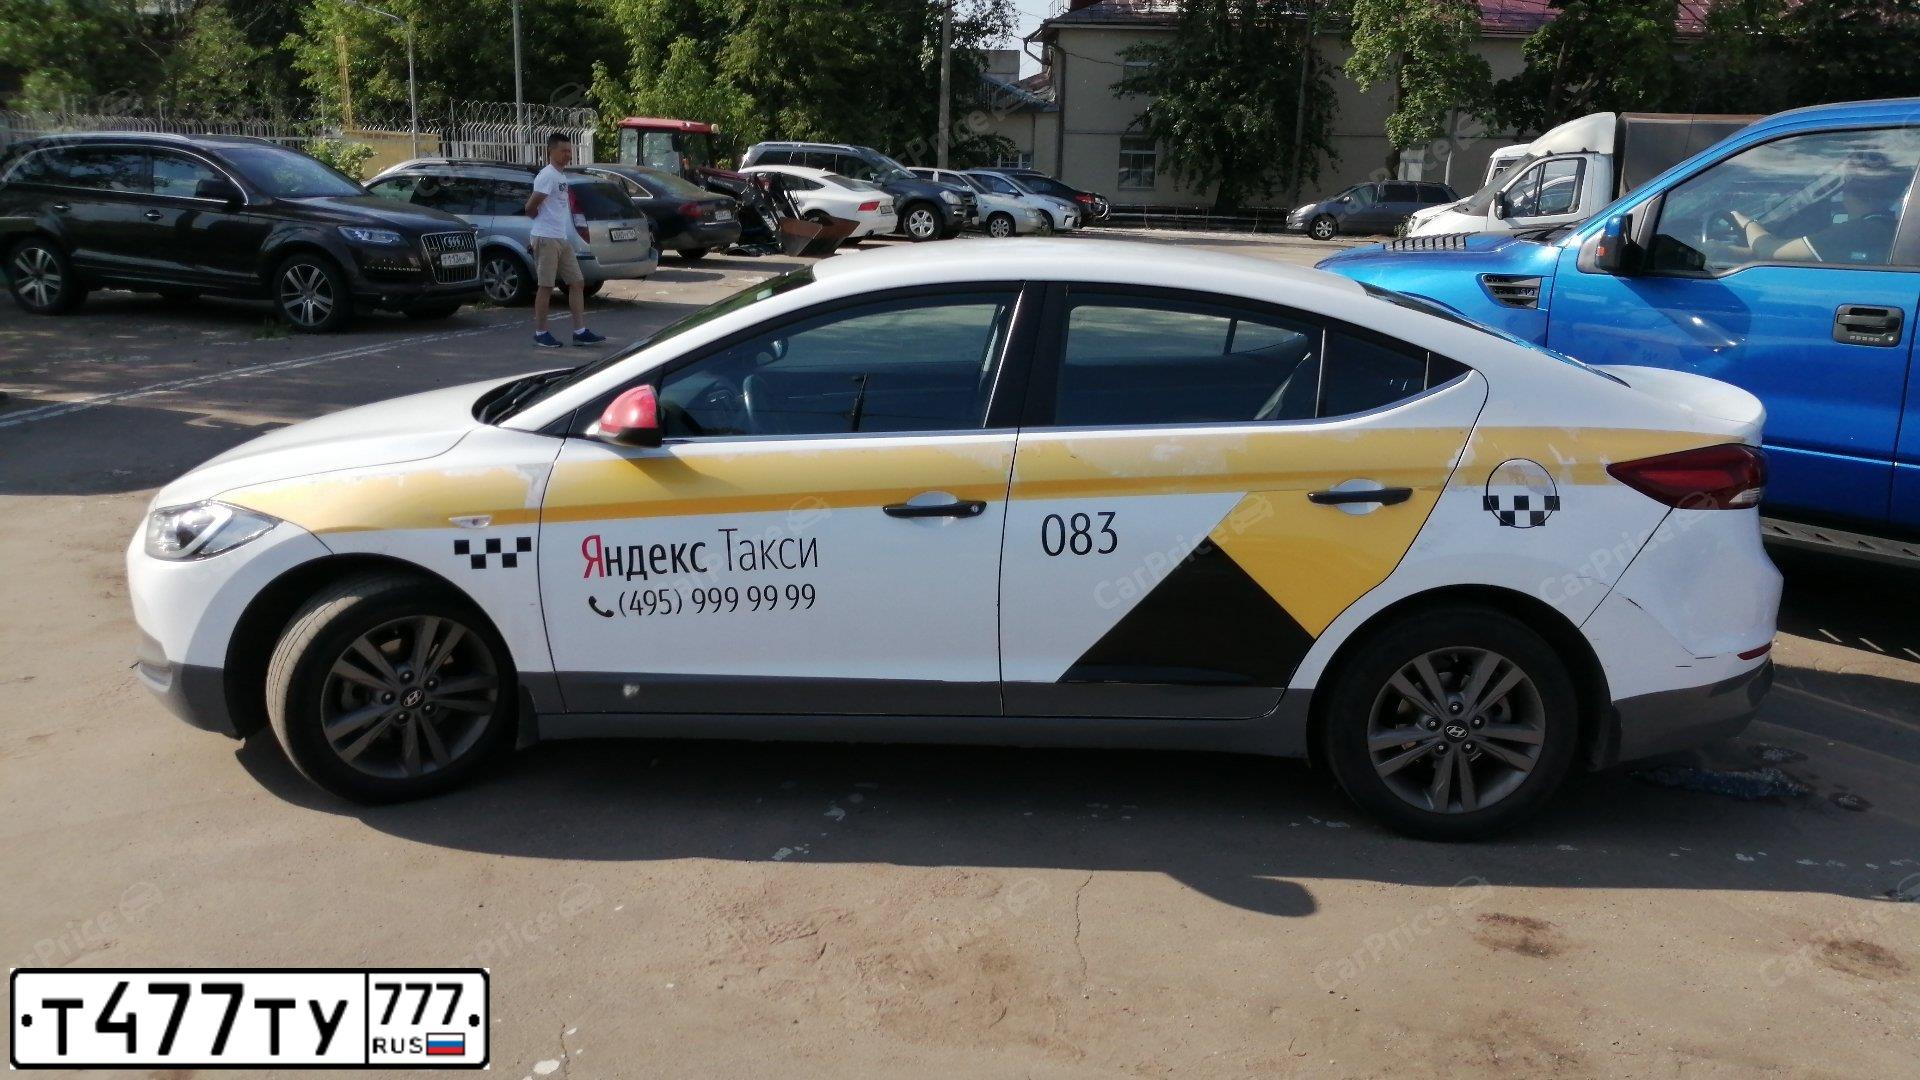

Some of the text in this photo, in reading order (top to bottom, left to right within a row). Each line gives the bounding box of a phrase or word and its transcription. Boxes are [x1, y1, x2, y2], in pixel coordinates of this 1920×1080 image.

[581, 528, 819, 581] Яндекс Такси
[1041, 511, 1118, 557] 083
[617, 583, 817, 618] (495) 999 99 99
